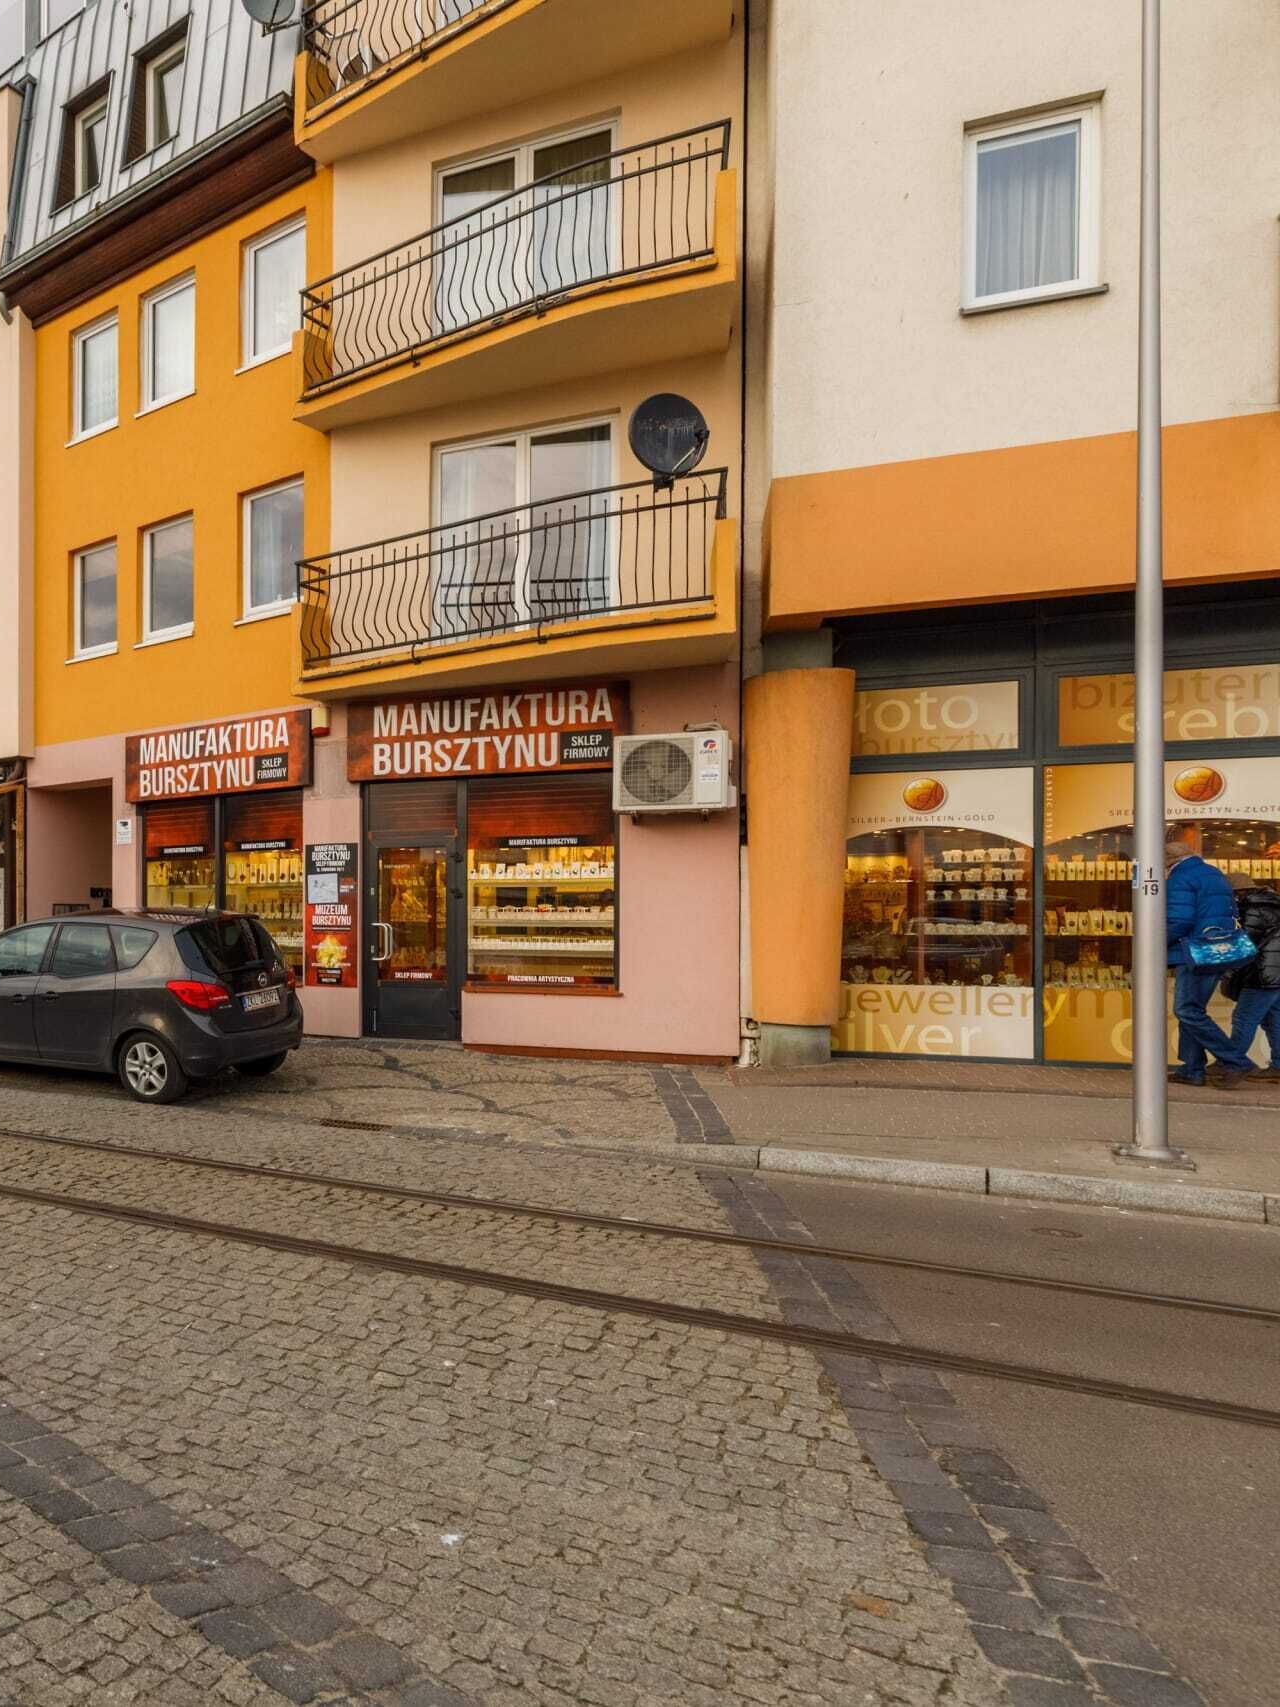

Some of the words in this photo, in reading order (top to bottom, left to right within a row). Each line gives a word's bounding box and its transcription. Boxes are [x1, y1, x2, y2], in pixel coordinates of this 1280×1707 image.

[372, 688, 613, 738] MANUFAKTURA
[139, 717, 289, 765] MANUFAKTURA
[571, 735, 602, 747] SKLEP
[373, 732, 558, 776] BURSZTYNU
[563, 746, 609, 760] FIRMOWY
[261, 757, 282, 769] SKLEP
[139, 756, 255, 797] BURSZTYNU
[257, 767, 287, 780] FIRMOWY
[895, 813, 954, 824] BERNSTEIN
[964, 812, 995, 822] GOLD
[311, 850, 351, 861] BURSZTYNU
[1142, 883, 1159, 896] 19
[314, 904, 348, 915] MUZEUM
[311, 915, 352, 926] BURSZTYNU
